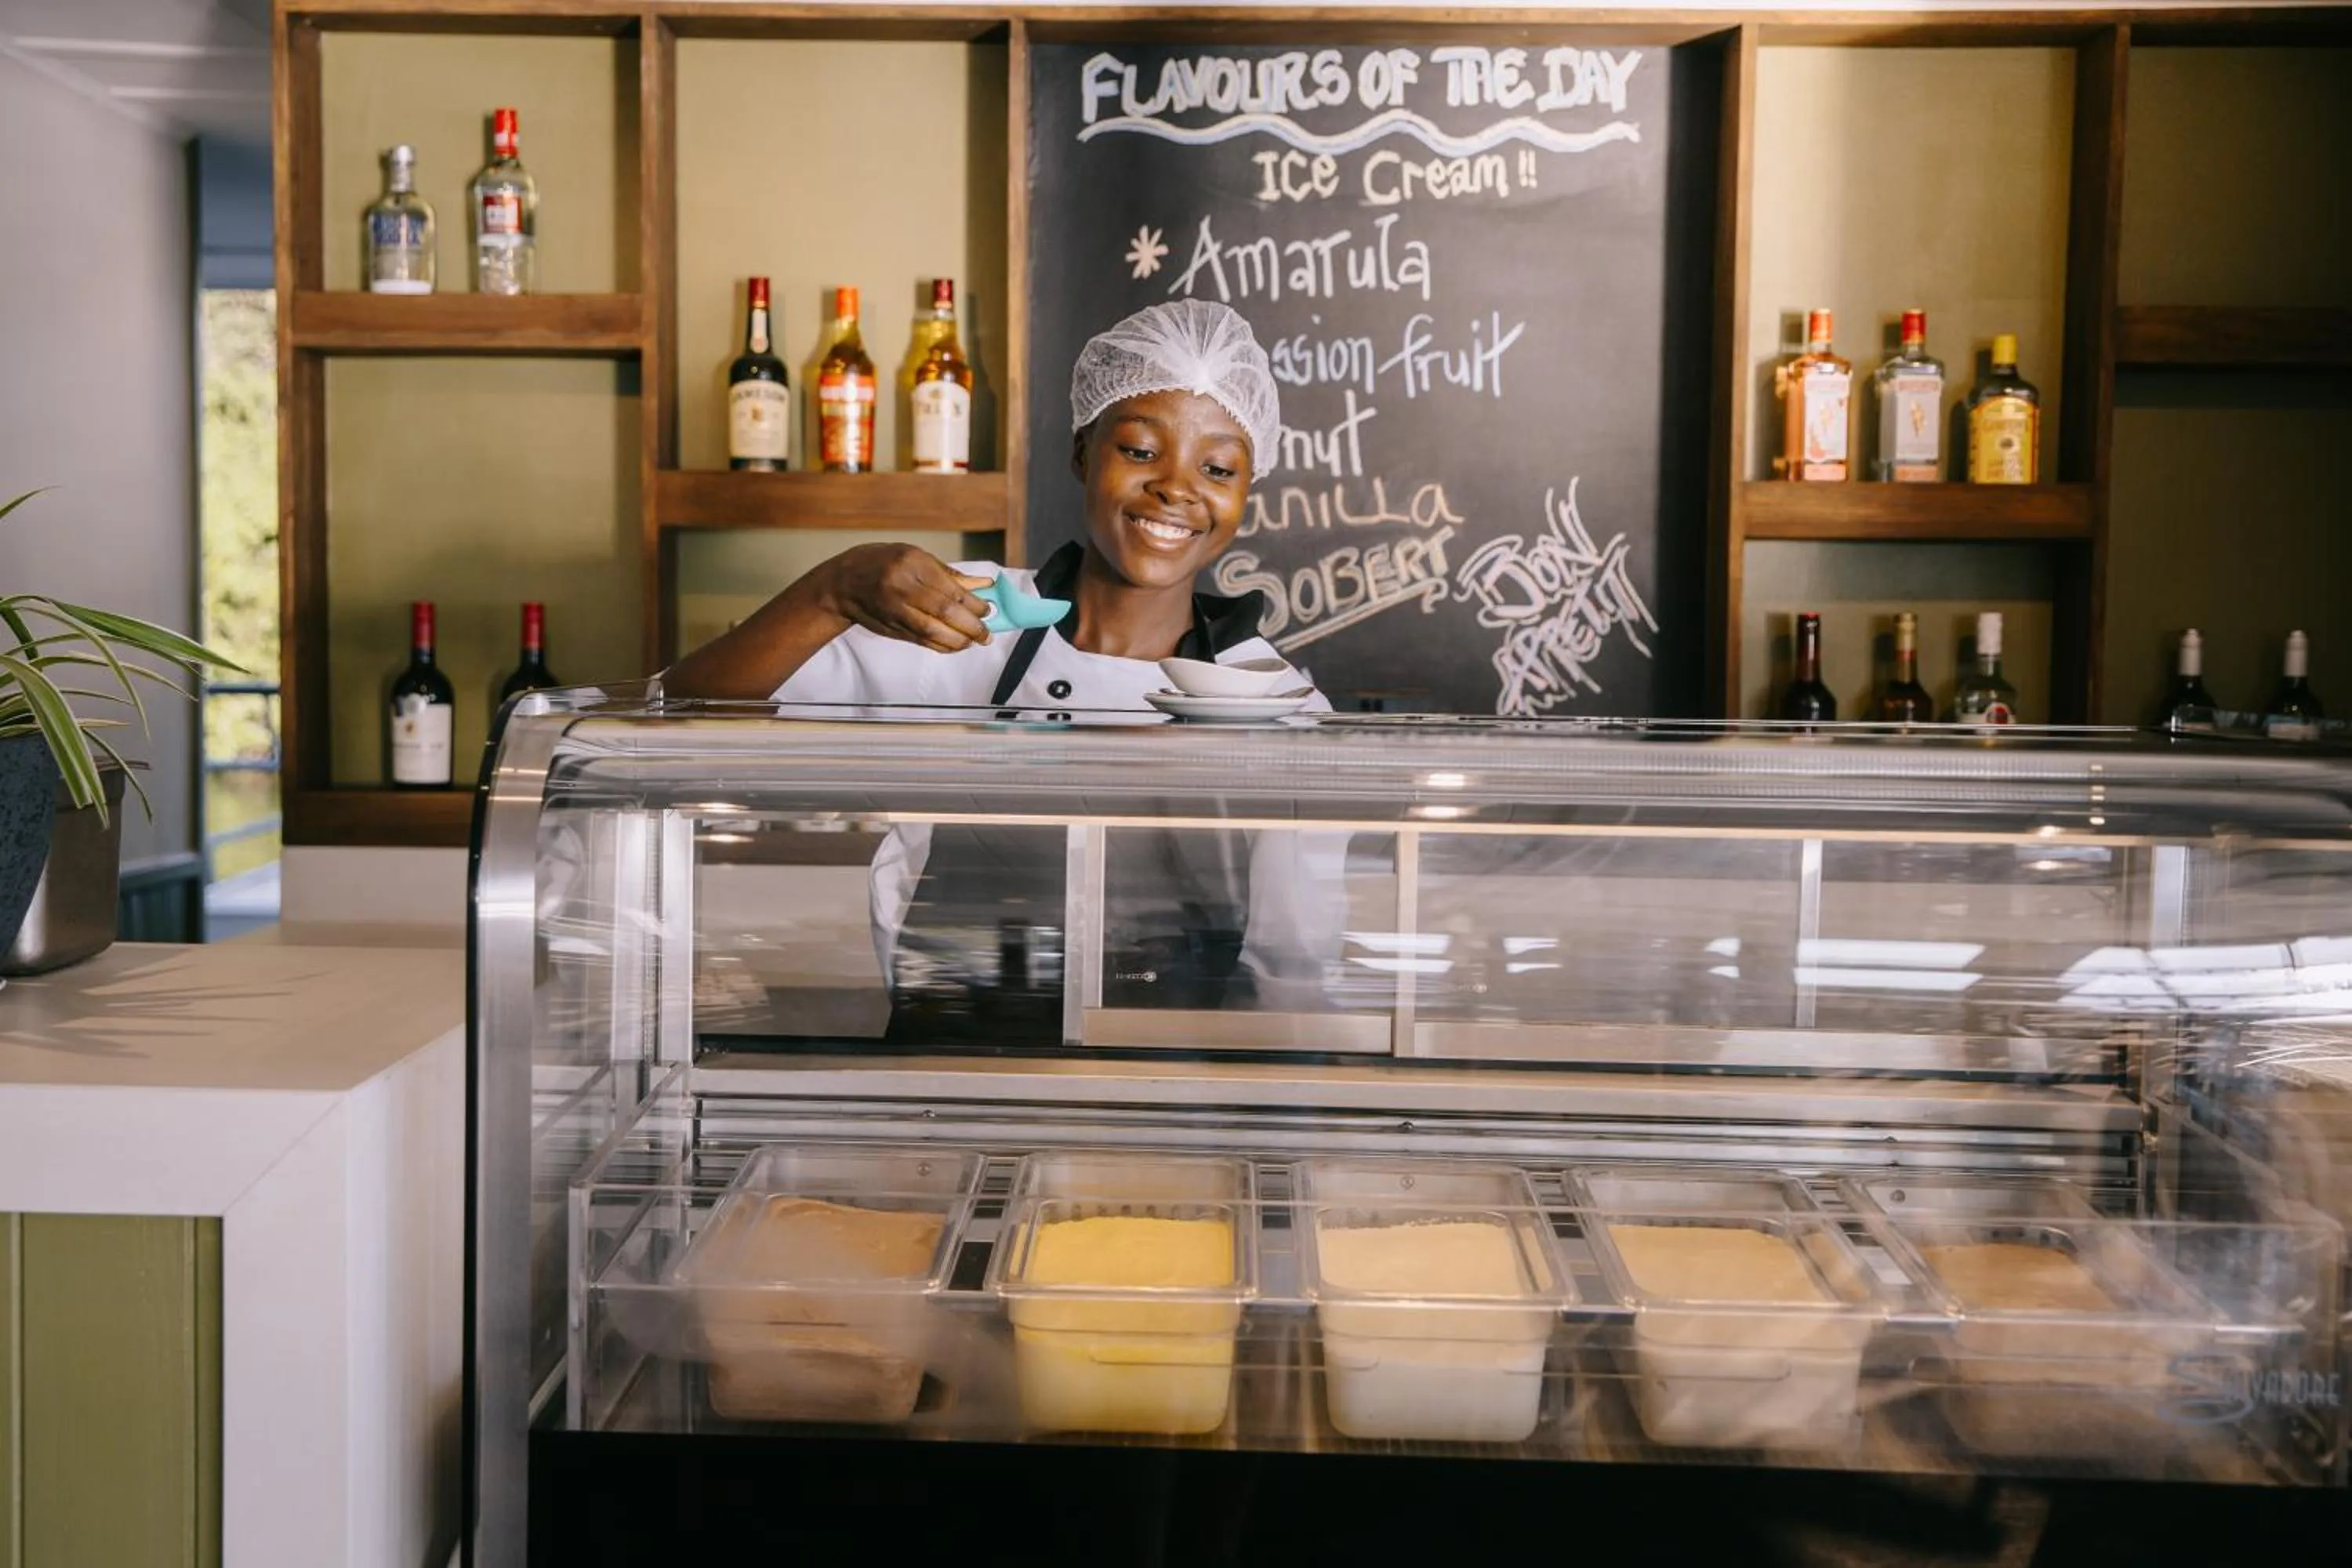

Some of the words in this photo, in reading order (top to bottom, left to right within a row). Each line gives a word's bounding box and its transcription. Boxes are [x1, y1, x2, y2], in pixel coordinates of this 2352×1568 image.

[1083, 49, 1351, 123] FLAVOURS
[1359, 49, 1421, 109] OF
[1430, 47, 1534, 108] THE
[1536, 47, 1642, 112] DAY
[1363, 150, 1509, 205] Cream
[1167, 212, 1431, 303] Amarula
[1272, 314, 1374, 394] ssion
[1378, 311, 1525, 398] fruit
[1280, 389, 1377, 477] nut
[1214, 524, 1455, 638] SOBERT
